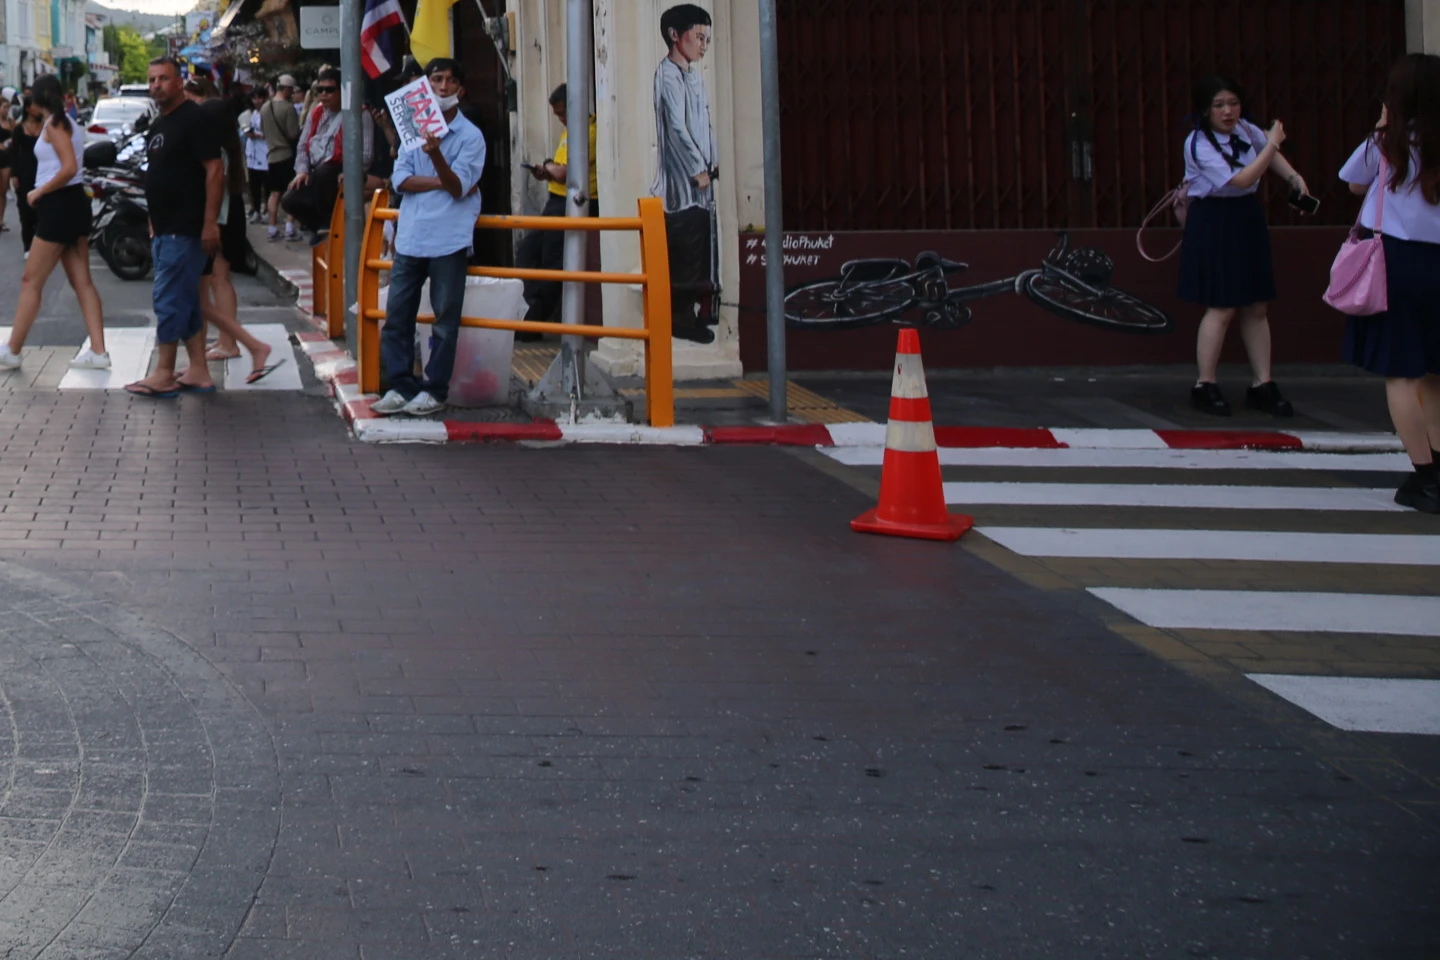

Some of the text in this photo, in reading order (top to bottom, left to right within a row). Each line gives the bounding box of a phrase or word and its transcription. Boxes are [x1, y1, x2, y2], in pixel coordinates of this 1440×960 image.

[305, 27, 340, 36] CAMPU
[389, 97, 416, 146] SERVICE
[405, 81, 443, 138] TAXI
